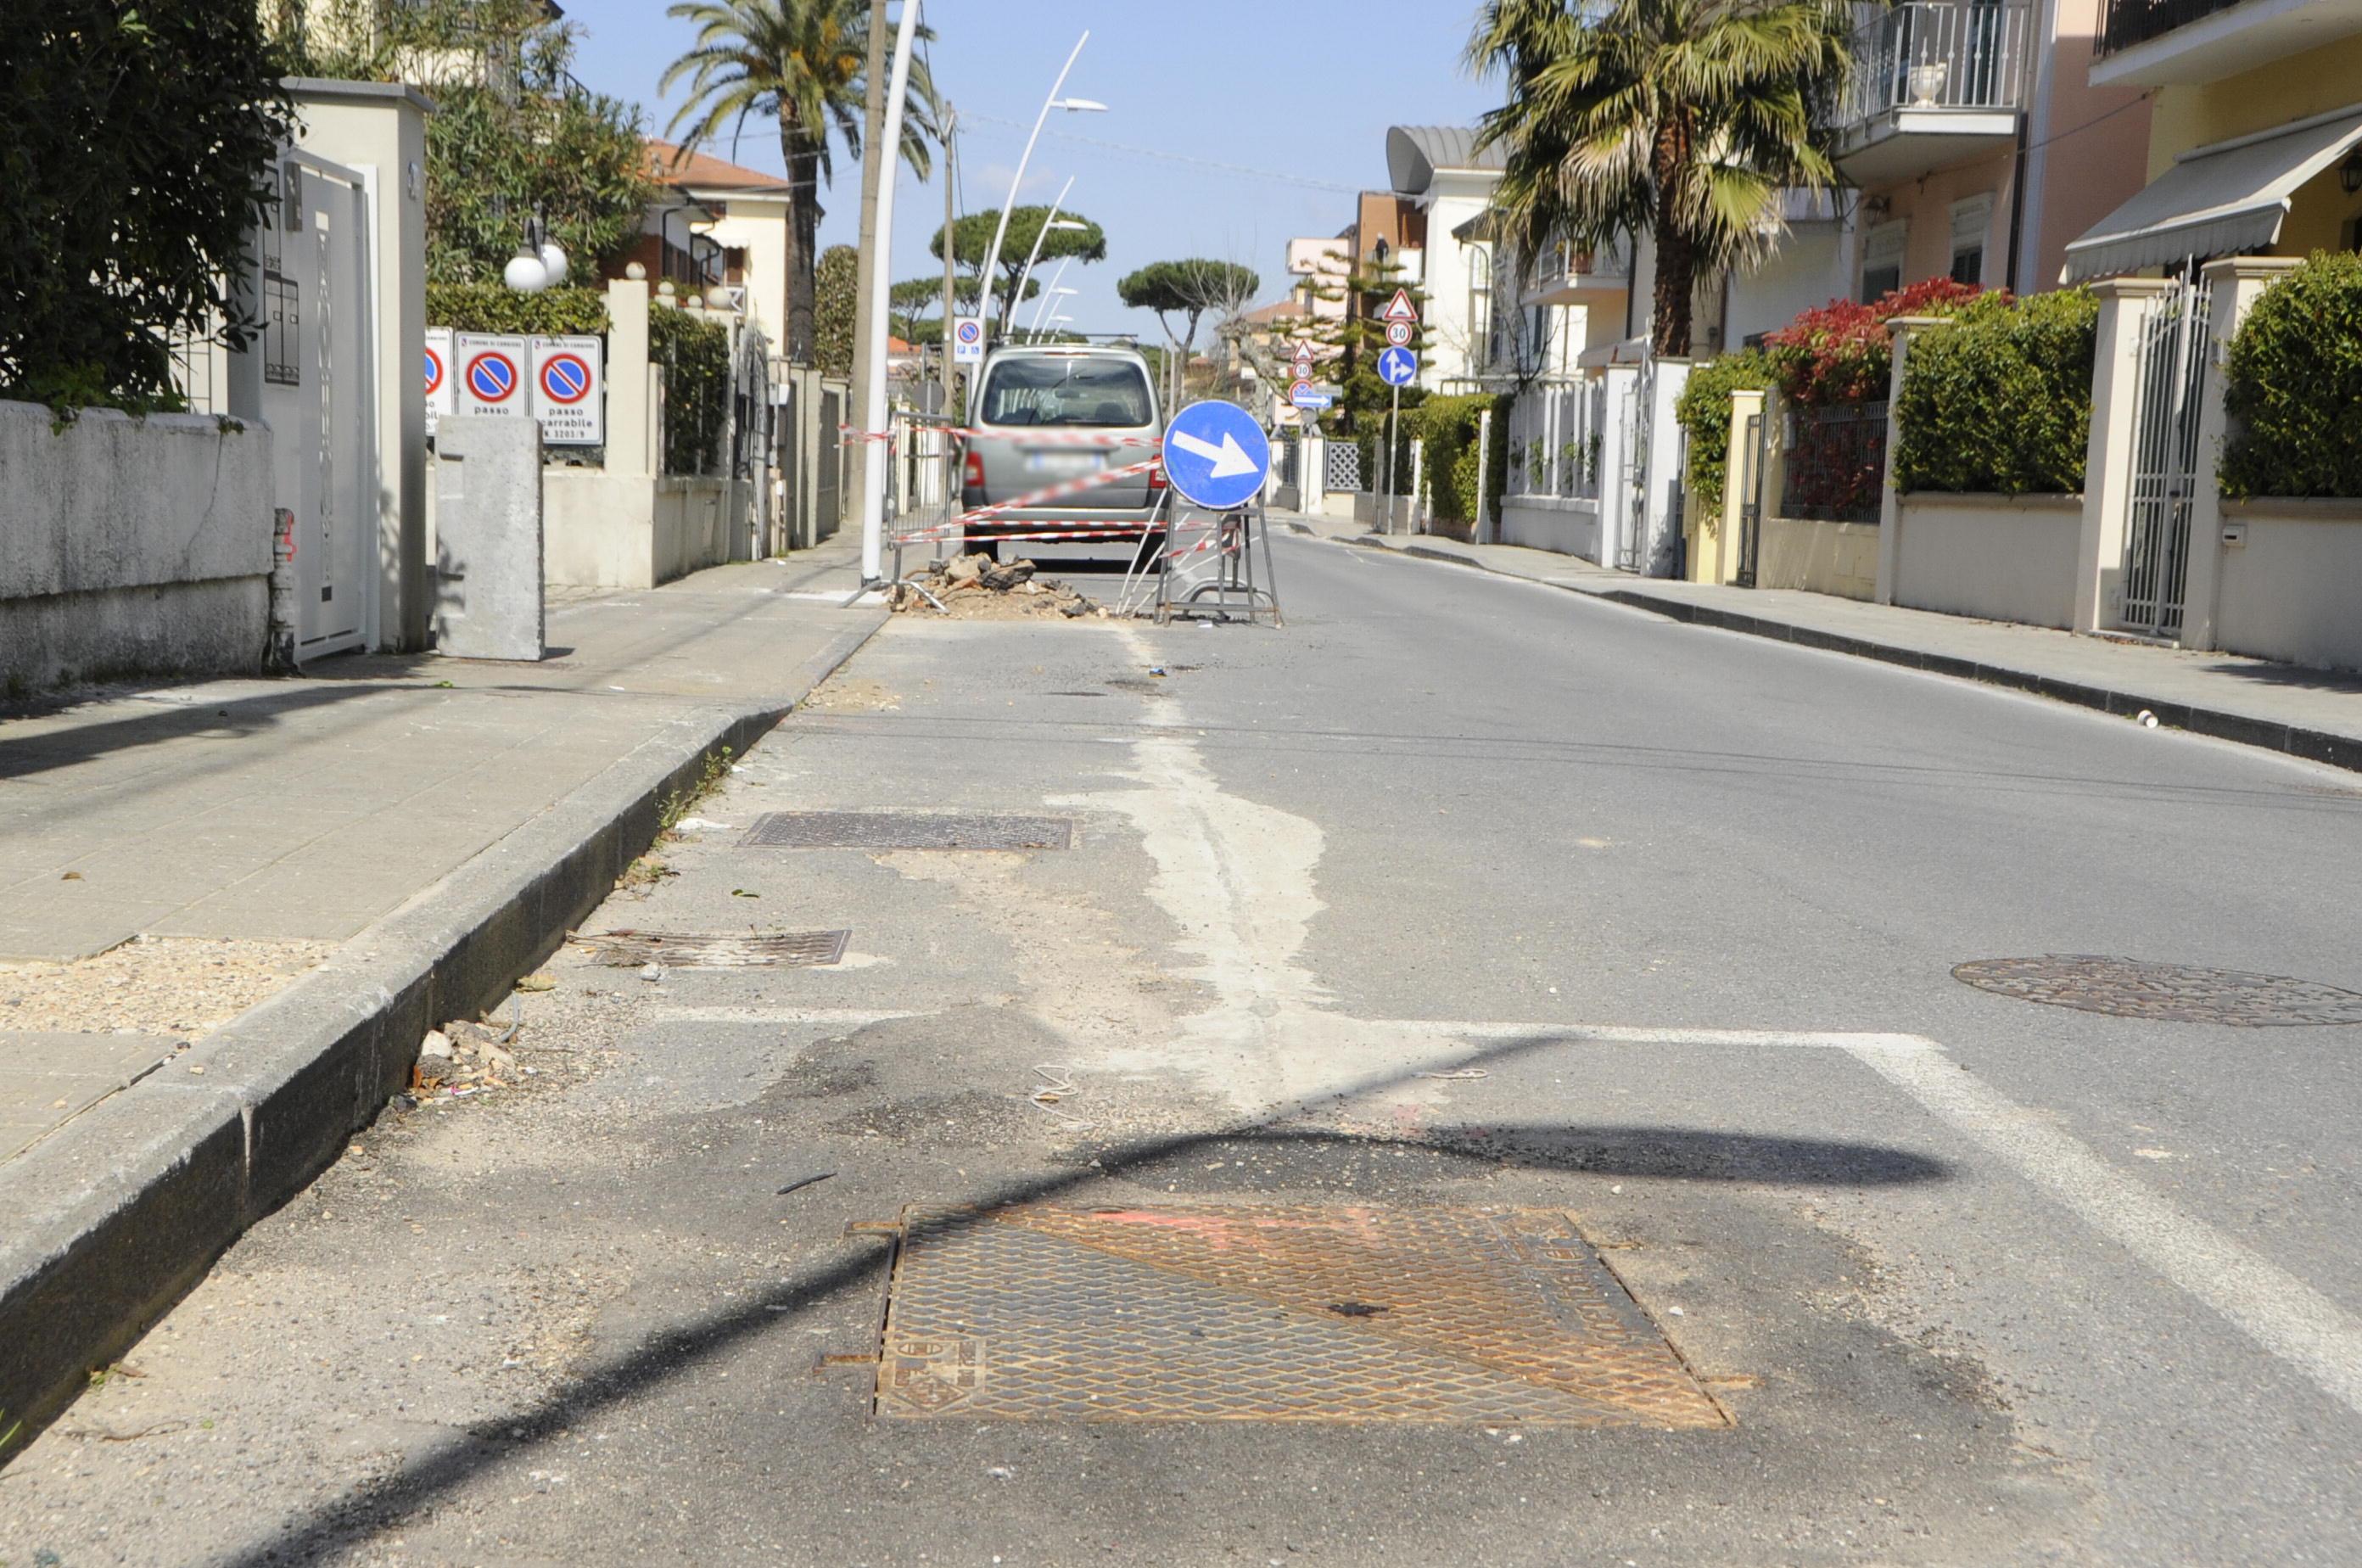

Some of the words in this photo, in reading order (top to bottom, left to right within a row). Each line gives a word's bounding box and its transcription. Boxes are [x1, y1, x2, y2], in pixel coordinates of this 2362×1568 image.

[1392, 327, 1406, 339] 30
[474, 406, 509, 415] passo
[549, 408, 584, 417] passo
[542, 418, 592, 428] carrabile
